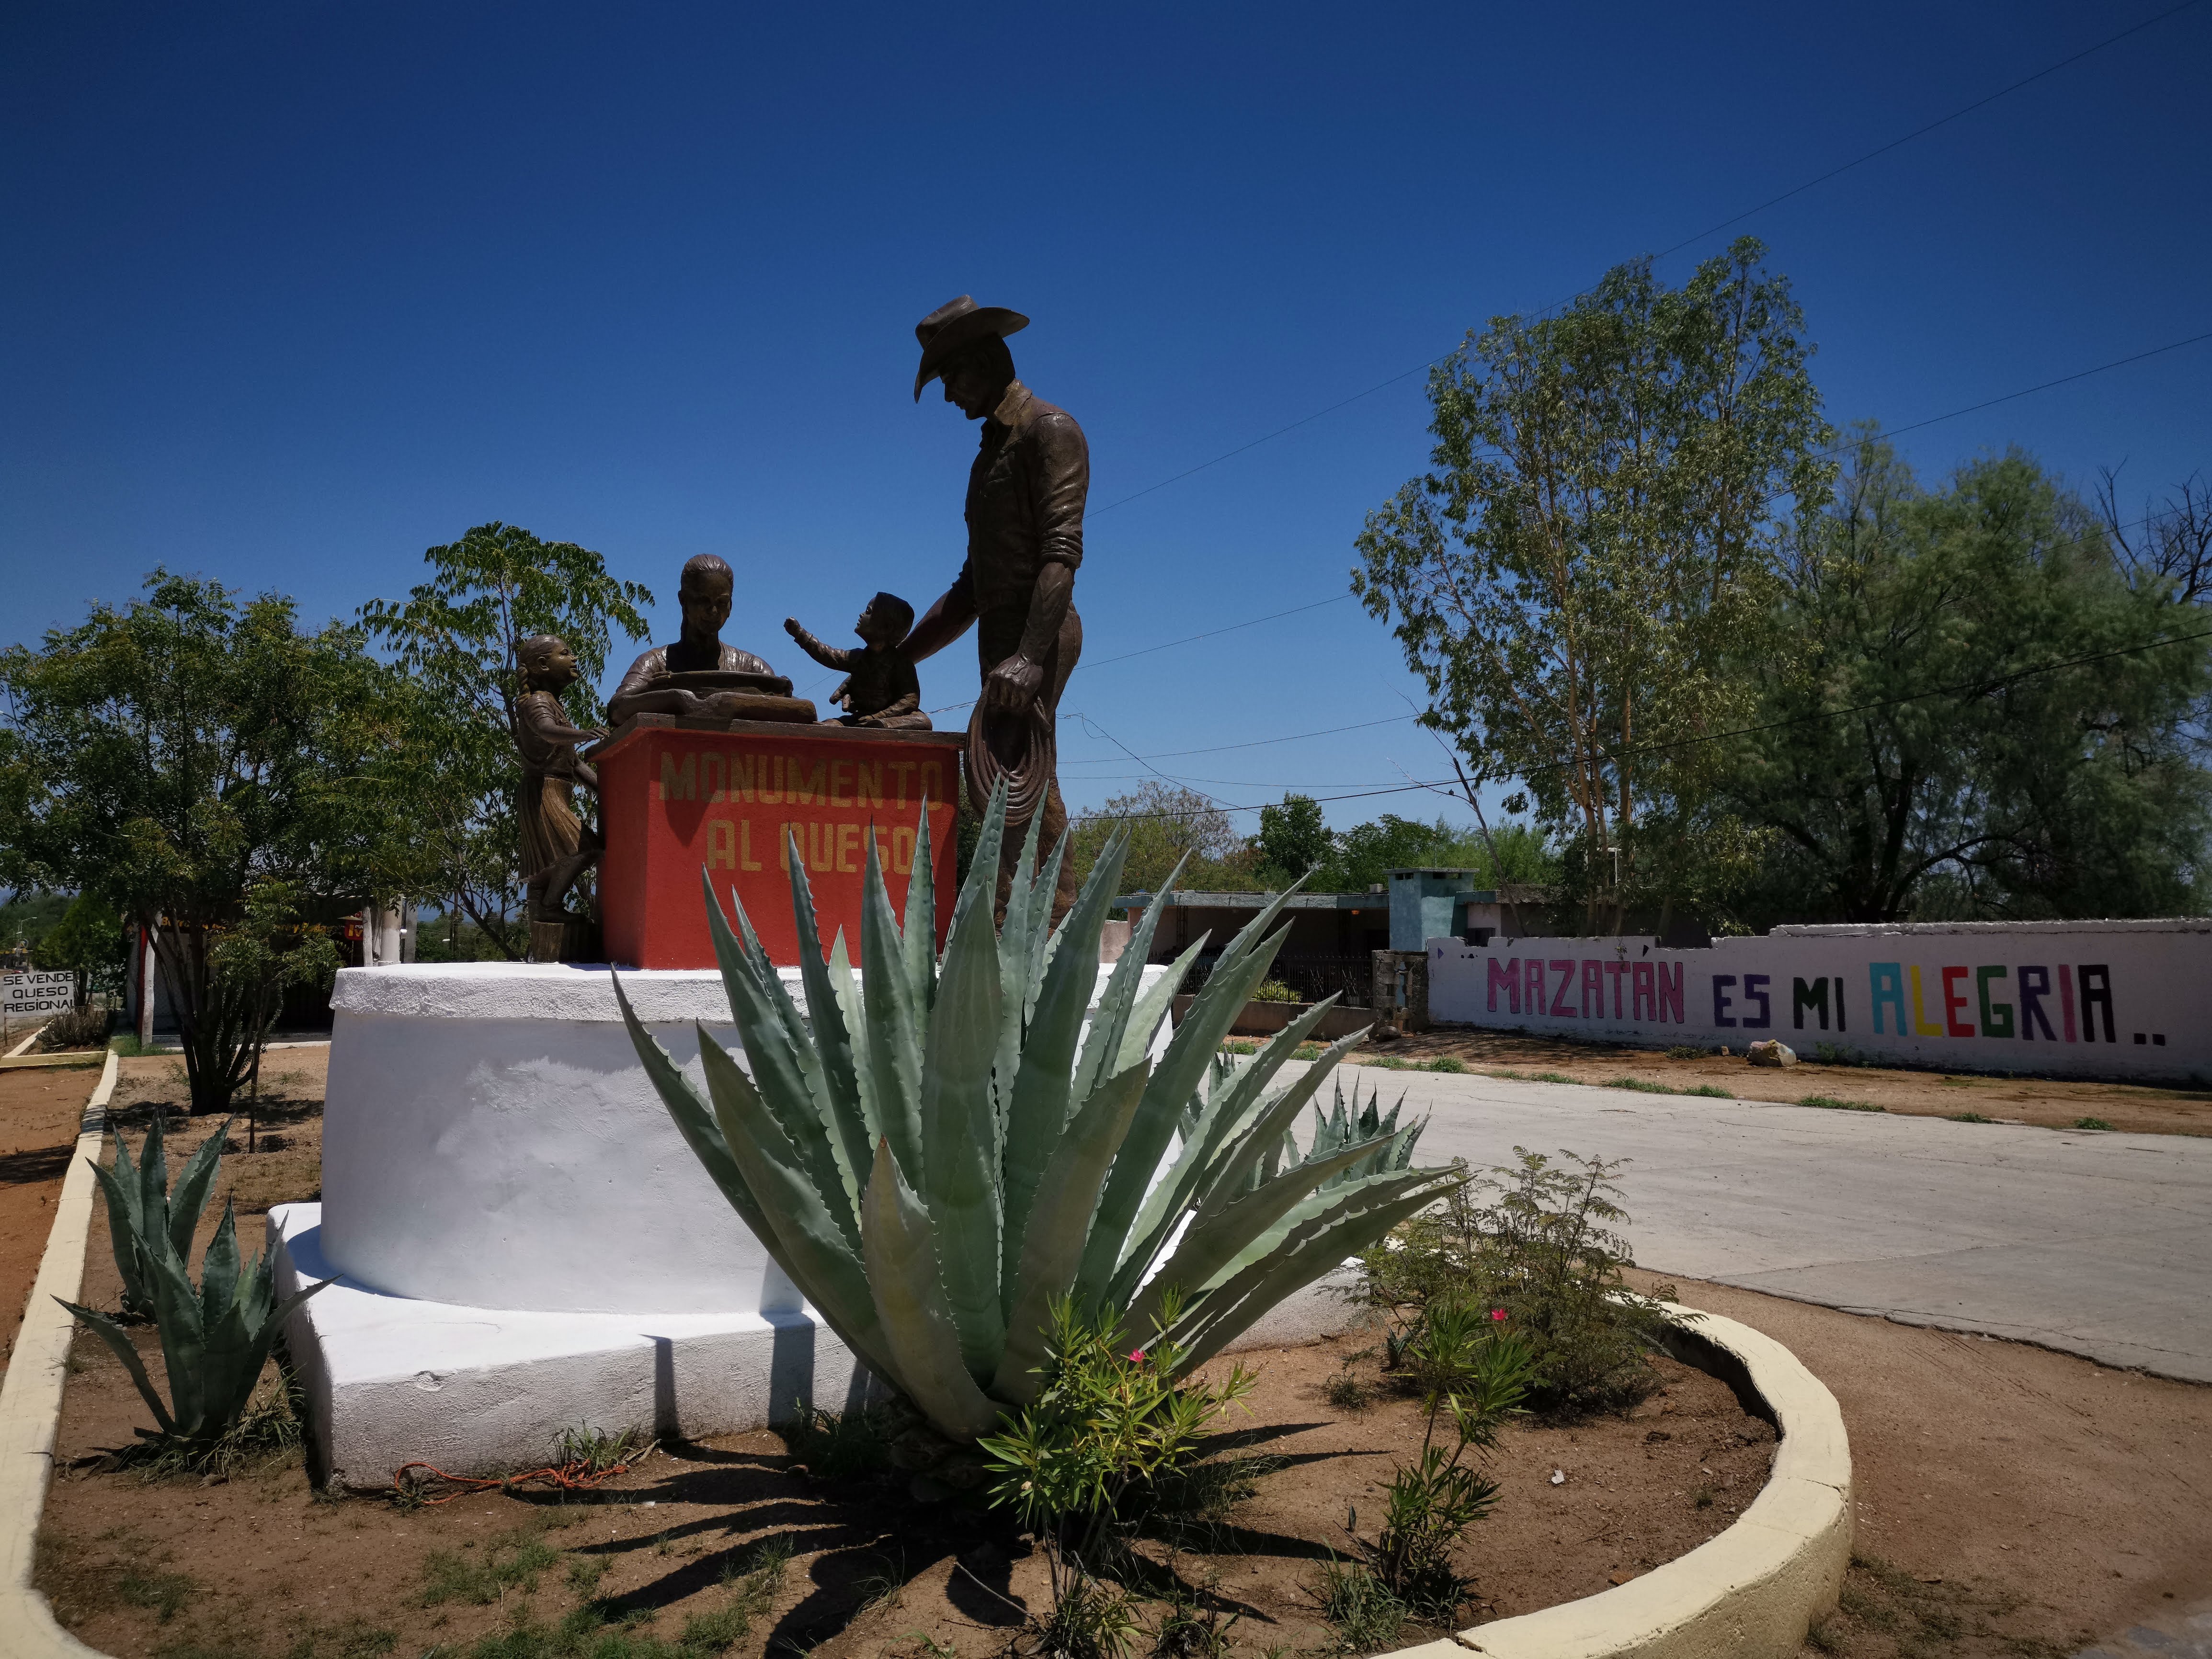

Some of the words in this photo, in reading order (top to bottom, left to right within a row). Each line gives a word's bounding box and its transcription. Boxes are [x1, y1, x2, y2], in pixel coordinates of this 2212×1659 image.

[659, 751, 943, 811] MONUMENTO
[707, 819, 762, 871] AL
[780, 822, 917, 879] QUESO
[3, 976, 23, 986] SE
[27, 972, 73, 984] VENDE
[12, 986, 68, 999] QUESO
[1712, 974, 1771, 1029] ES
[1793, 977, 1846, 1032] MI
